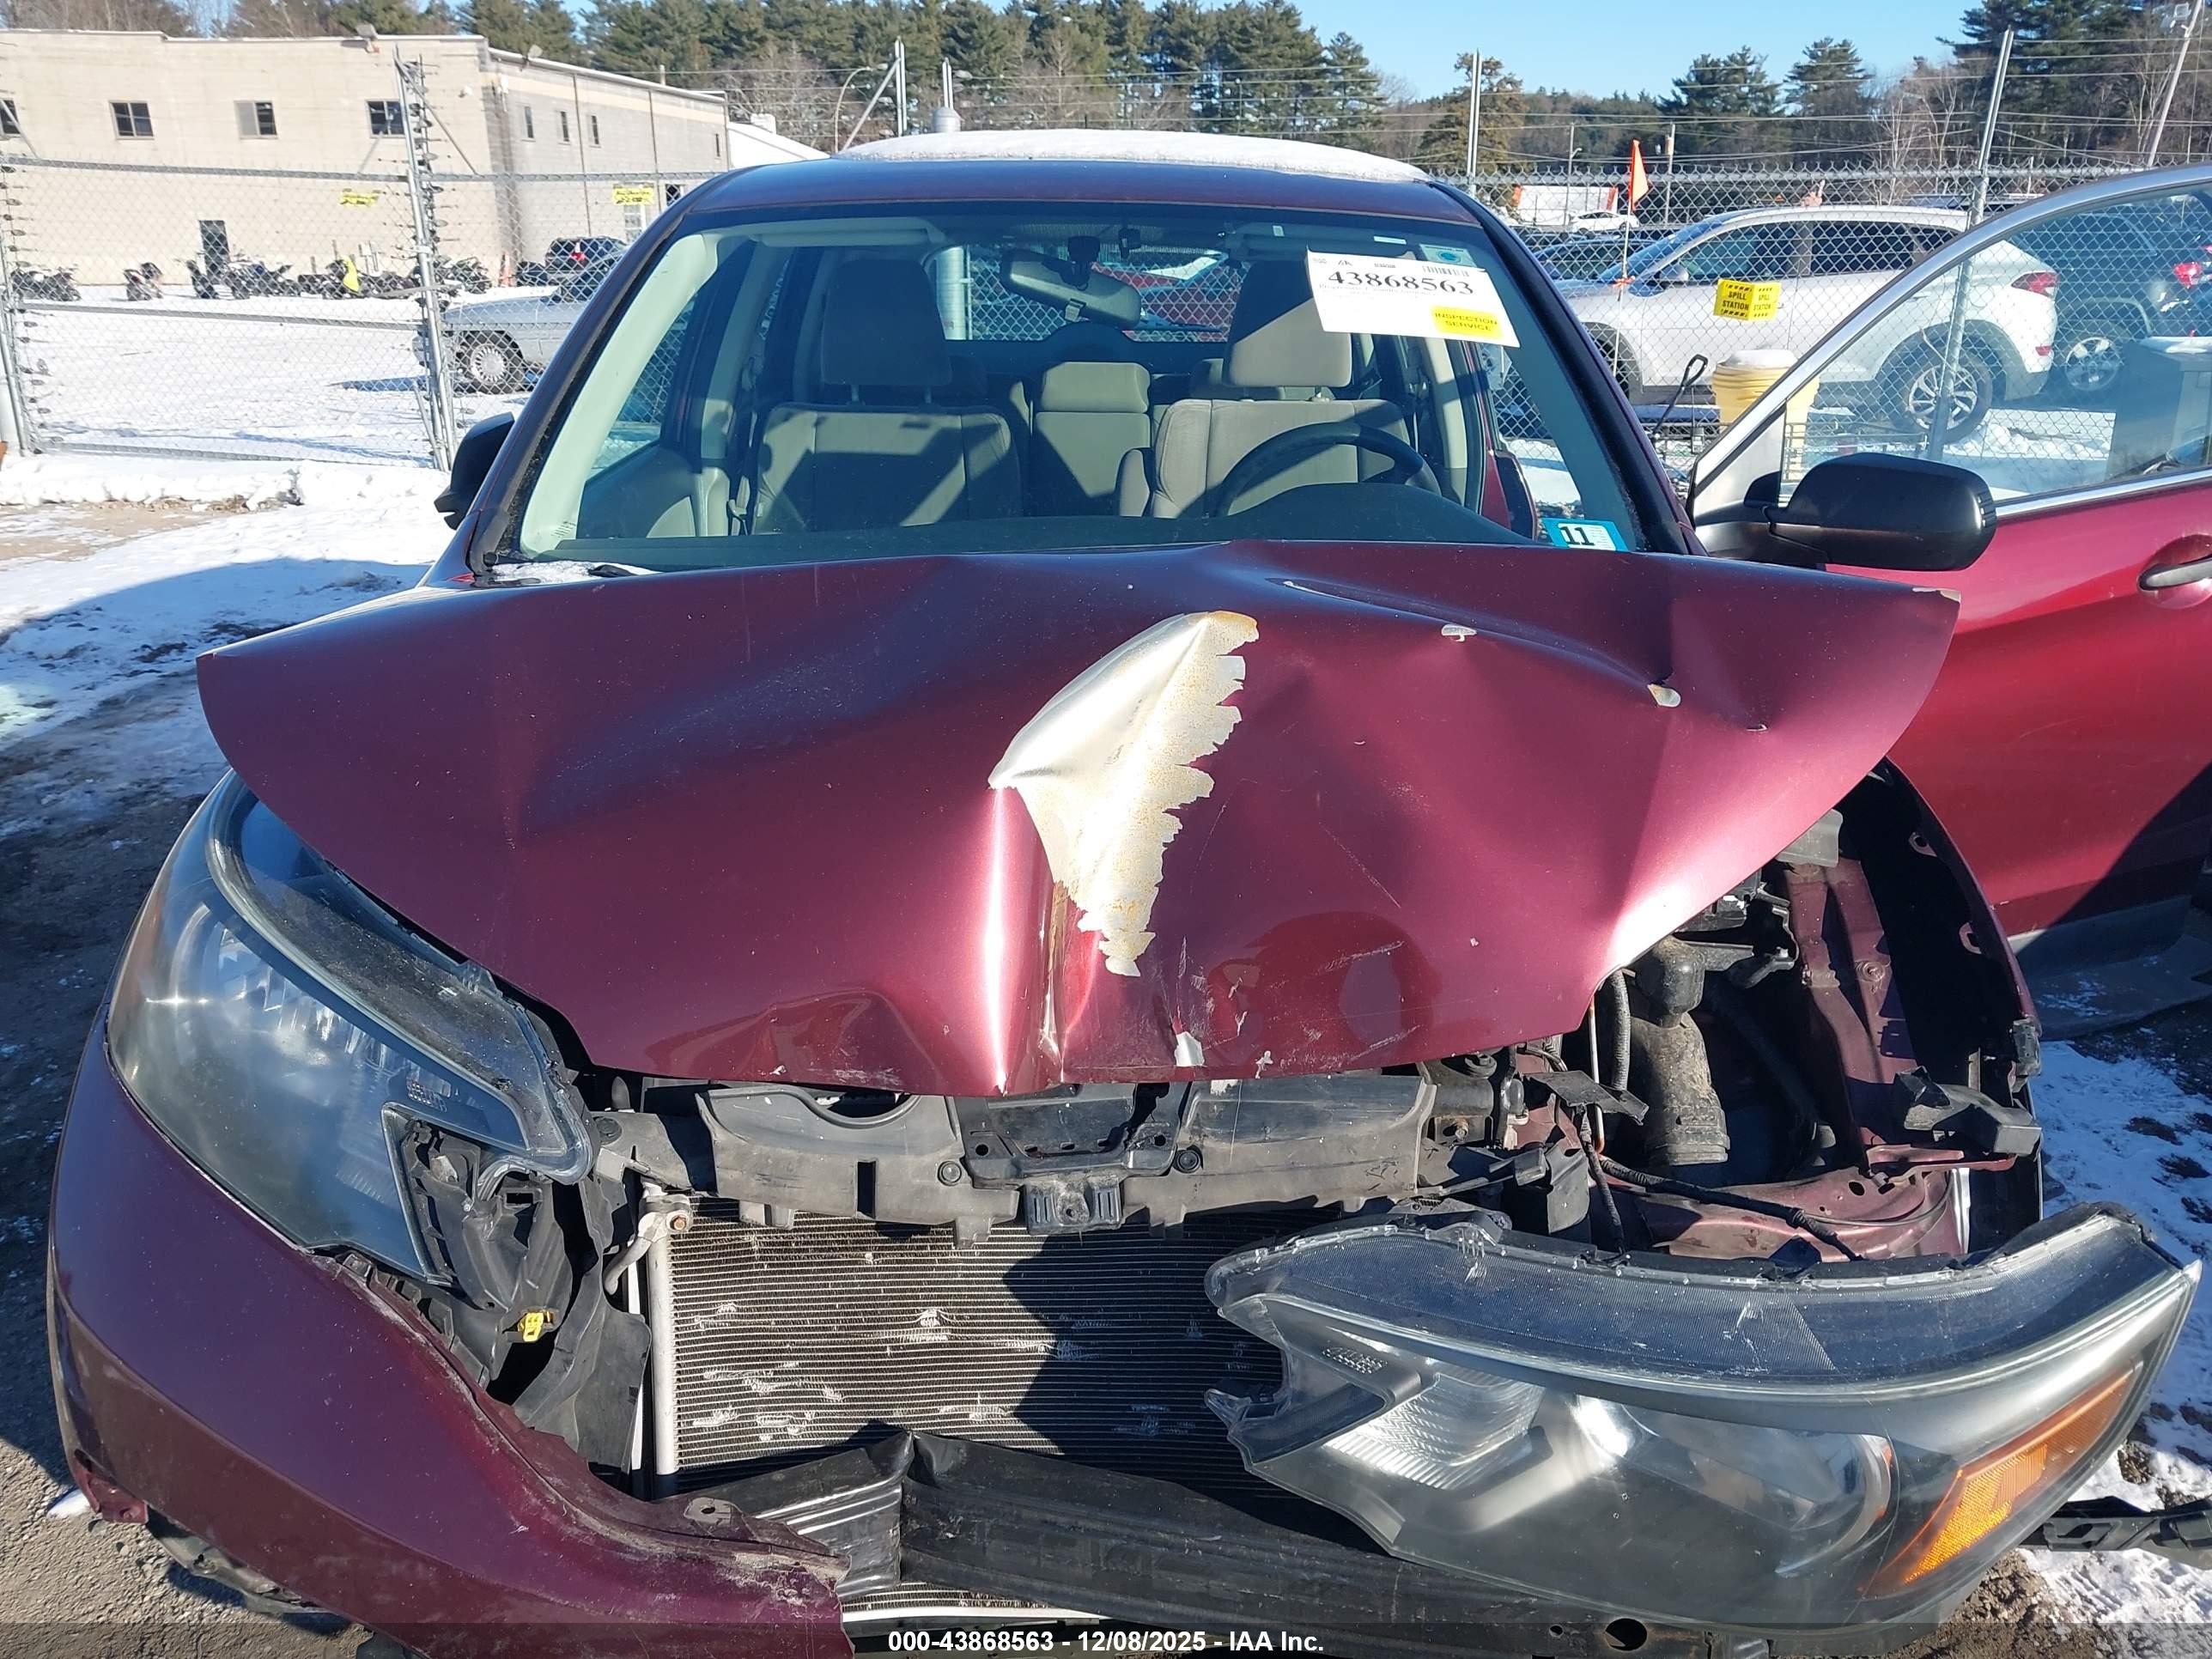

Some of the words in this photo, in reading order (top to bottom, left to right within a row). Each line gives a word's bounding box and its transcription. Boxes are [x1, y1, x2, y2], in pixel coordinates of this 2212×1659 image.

[1328, 270, 1474, 295] 43868563
[1728, 291, 1747, 301] SPILL
[1722, 301, 1749, 310] STATION
[1435, 313, 1498, 325] INSPECTION
[1560, 526, 1595, 546] 11
